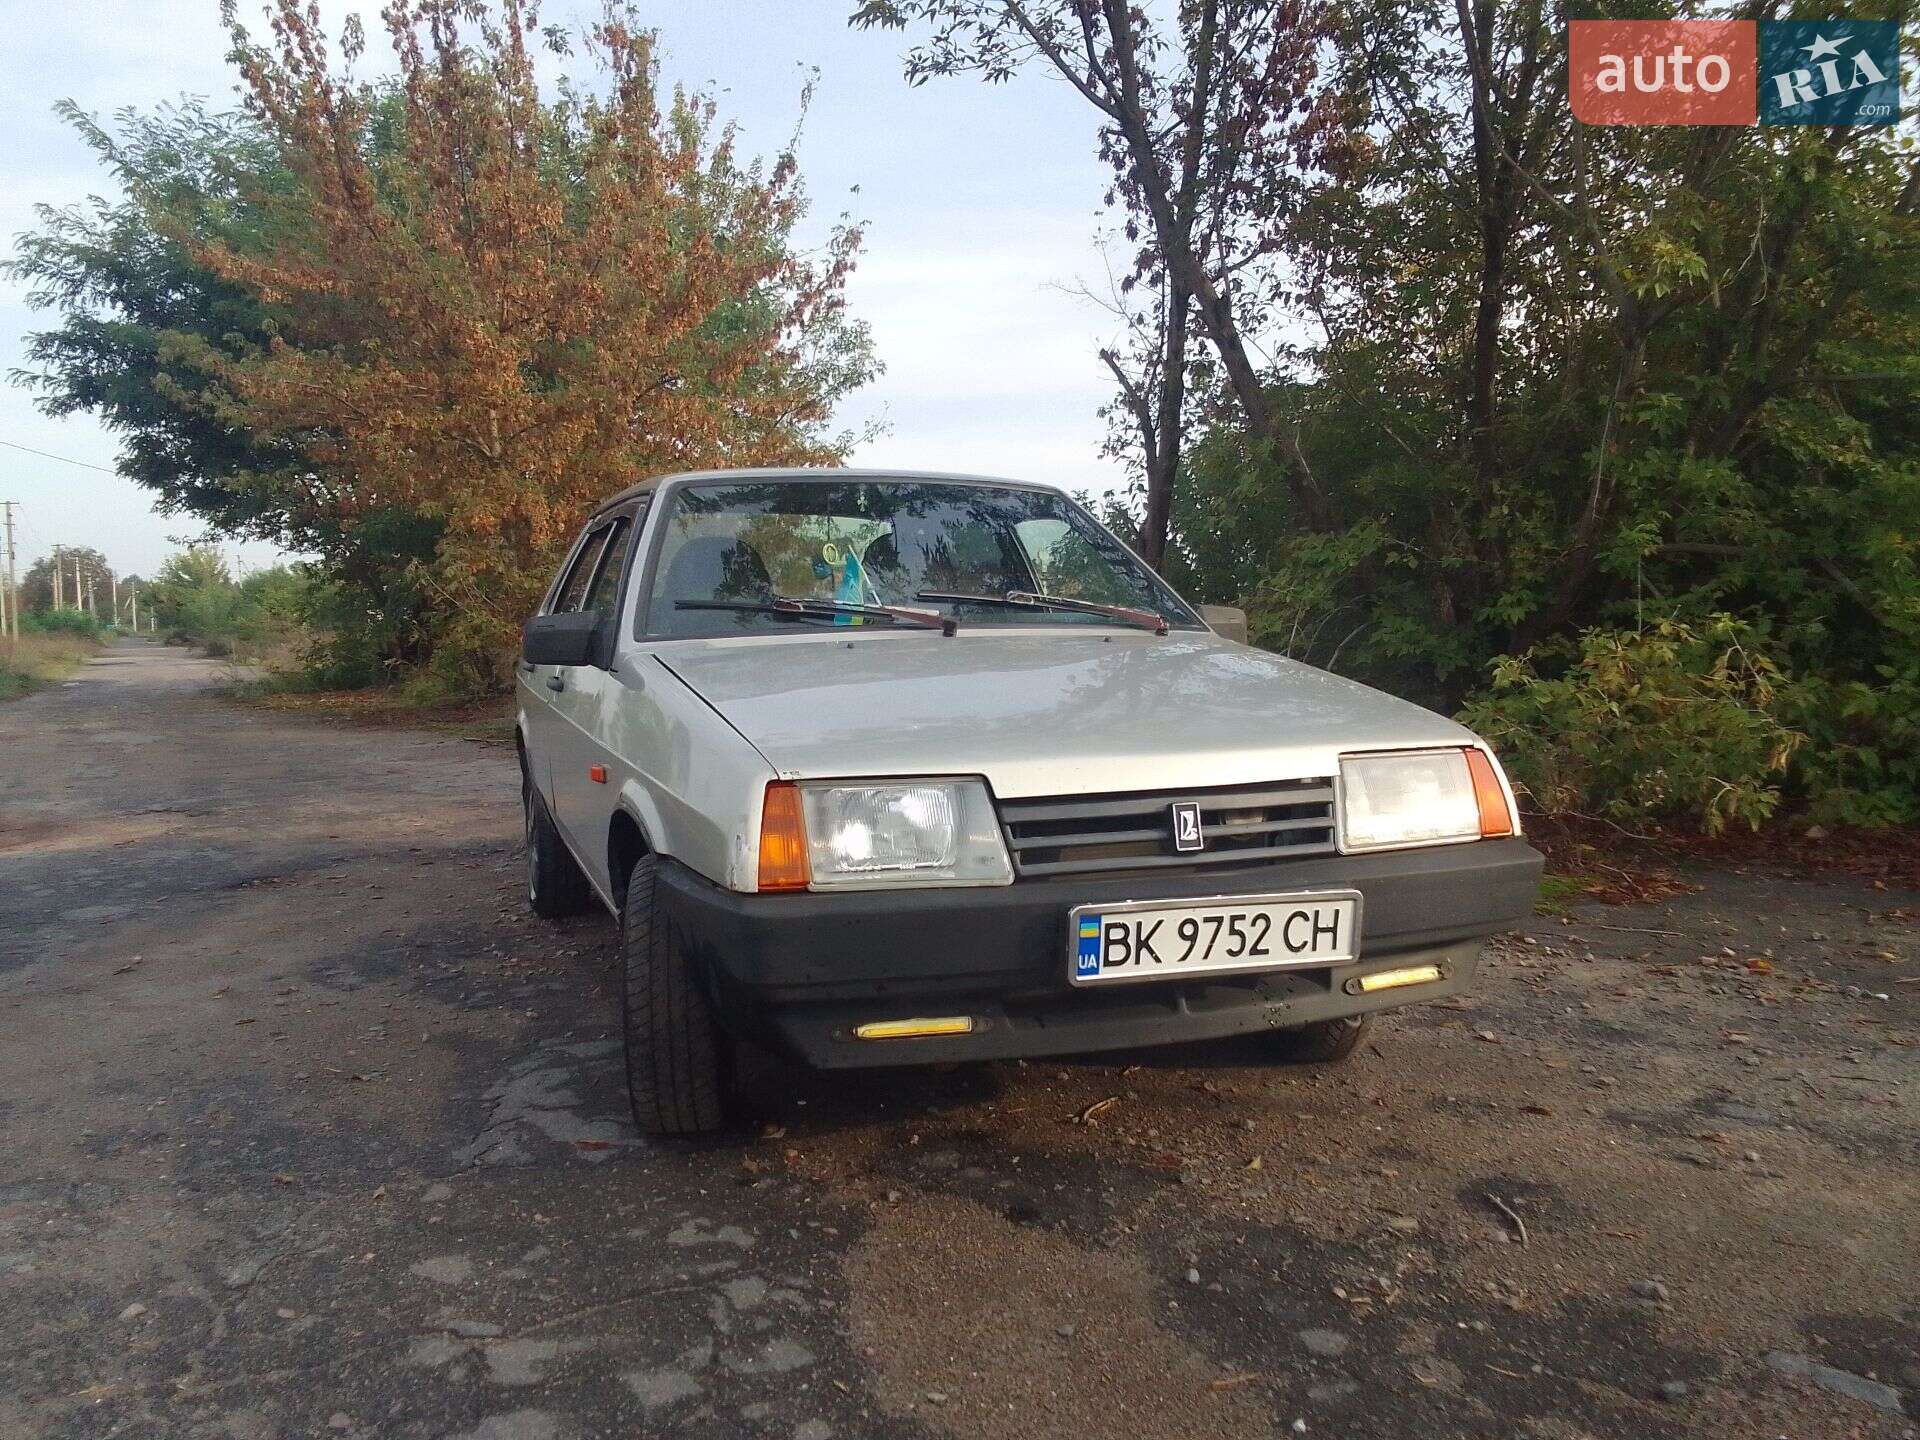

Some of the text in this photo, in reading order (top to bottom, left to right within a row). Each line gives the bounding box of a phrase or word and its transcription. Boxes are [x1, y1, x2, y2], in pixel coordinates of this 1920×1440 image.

[1103, 908, 1340, 968] BK 9752 CH
[1078, 954, 1098, 970] UA
